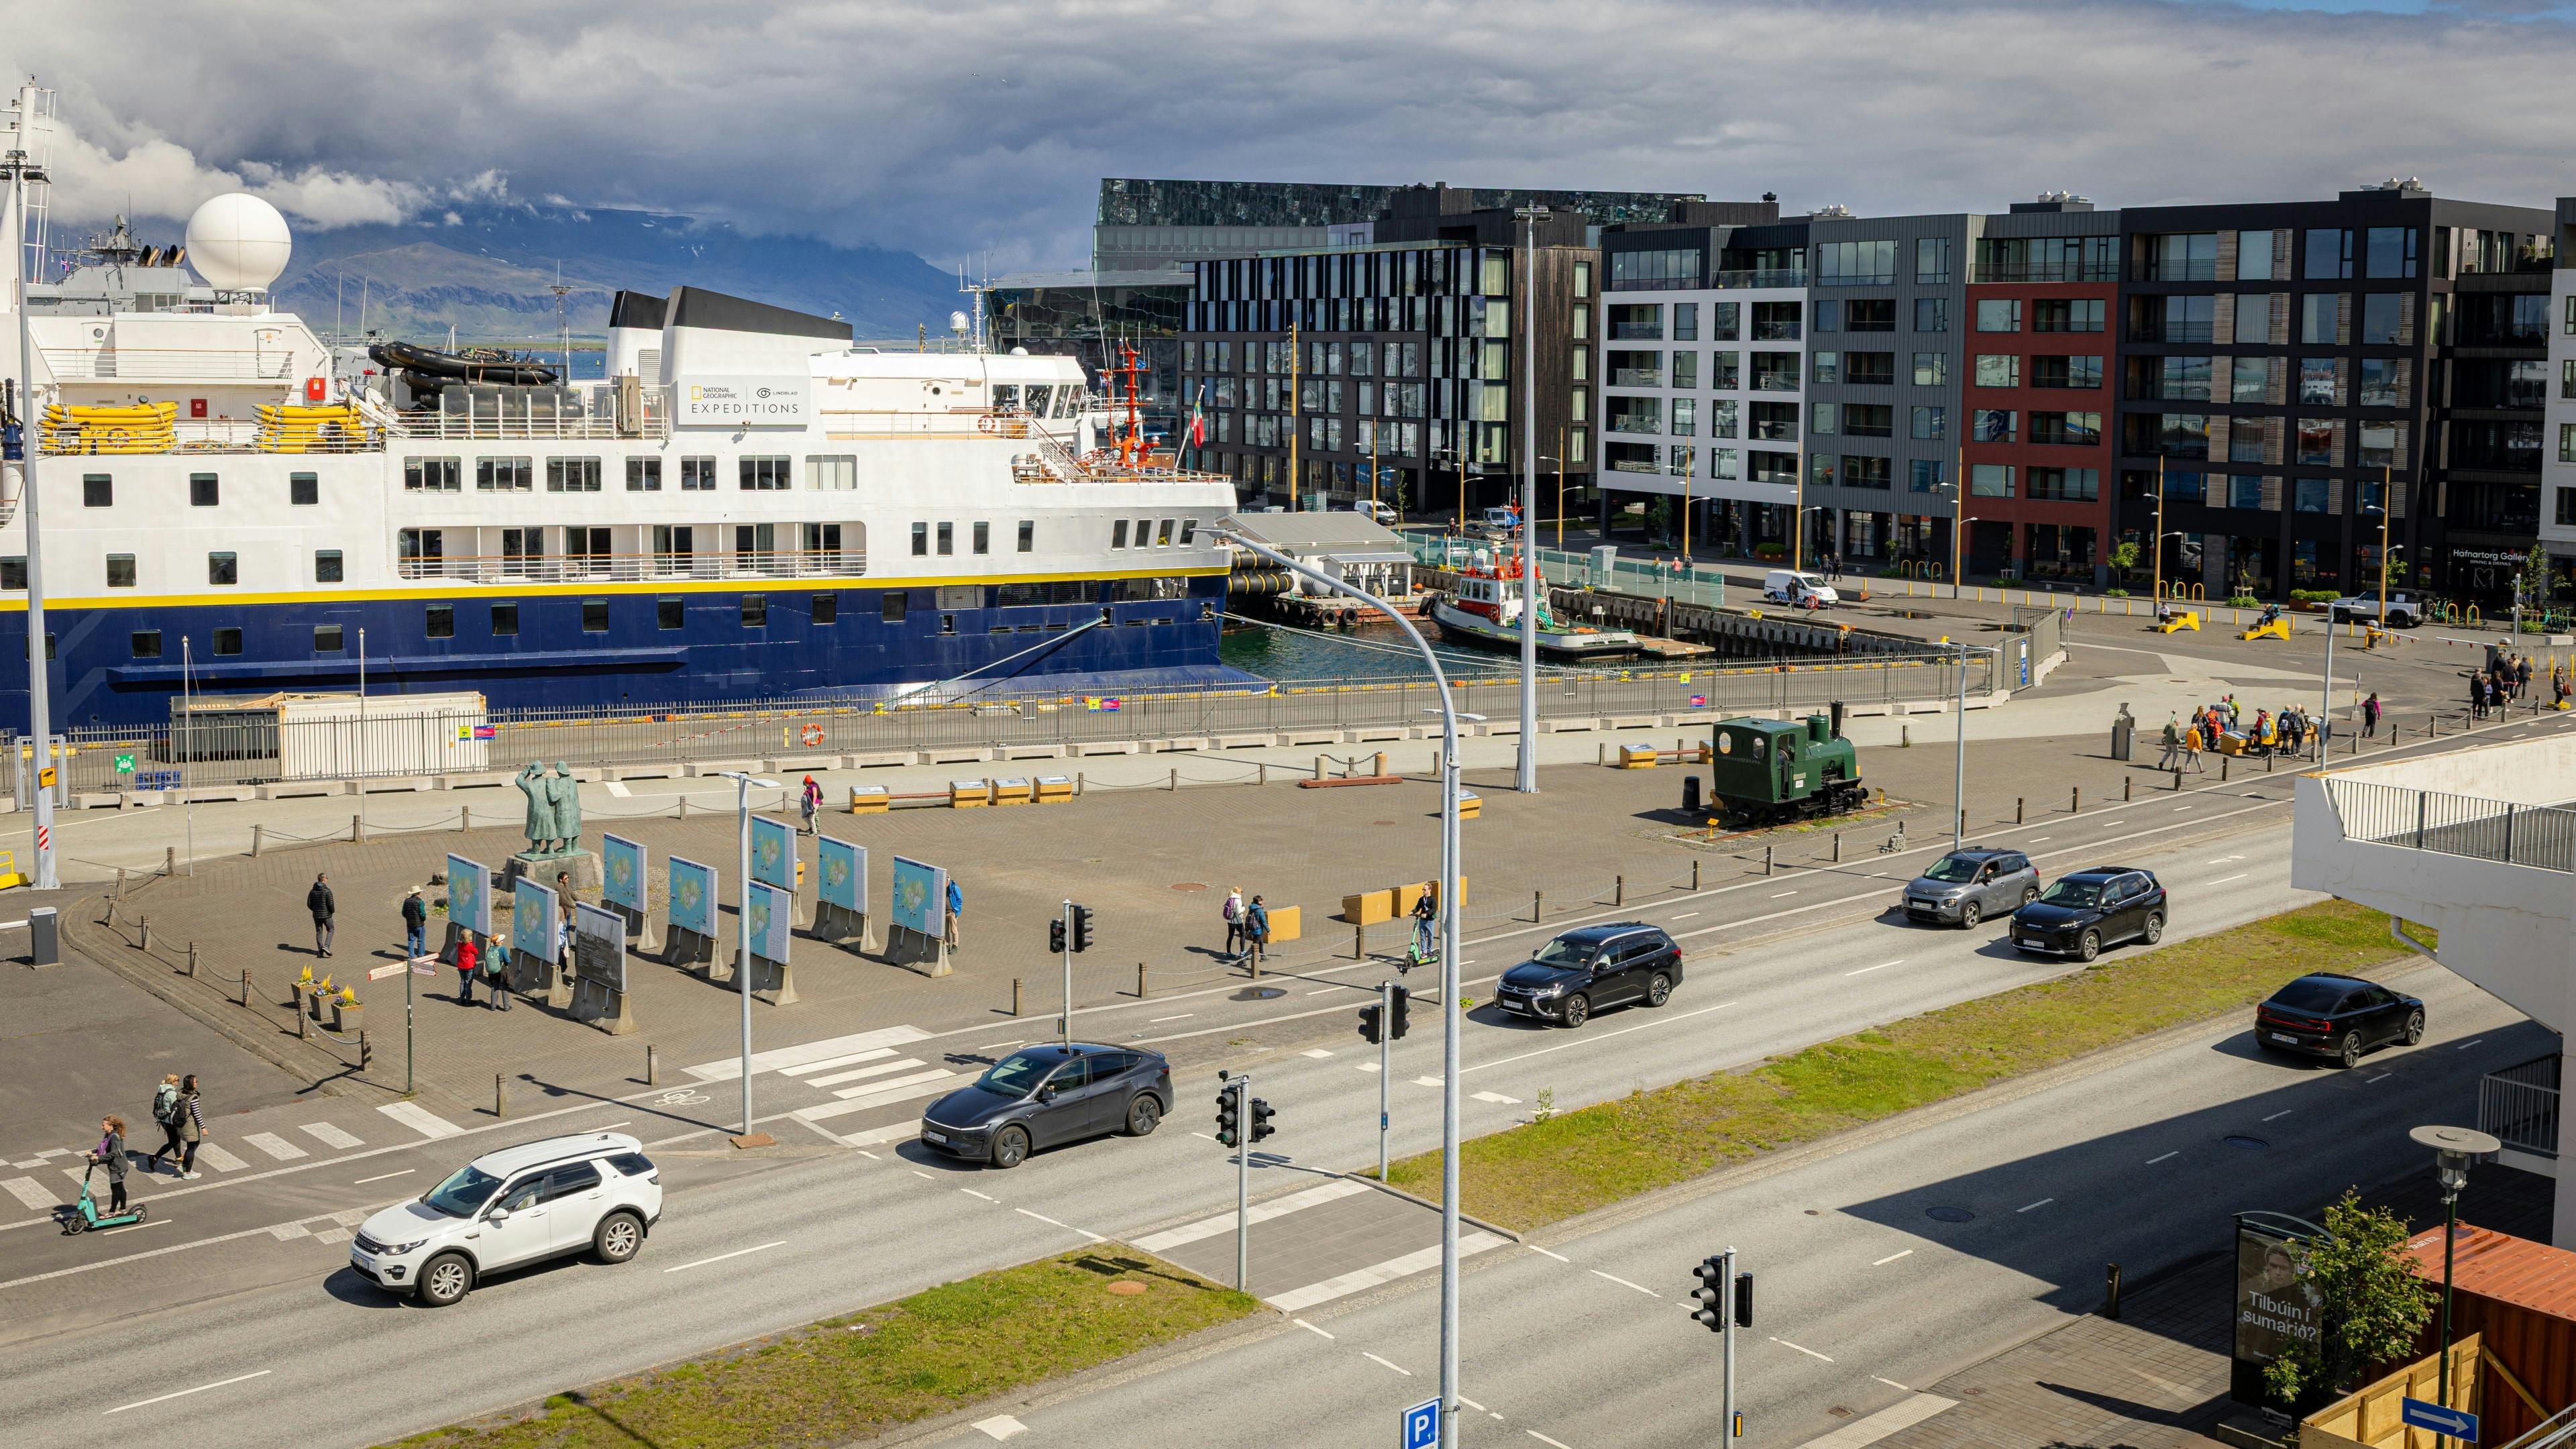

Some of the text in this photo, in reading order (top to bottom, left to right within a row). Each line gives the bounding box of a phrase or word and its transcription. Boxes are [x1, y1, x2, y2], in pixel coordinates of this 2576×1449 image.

[692, 404, 798, 413] EXPEDITIONS
[2453, 549, 2530, 563] Hafnartorg Gallery
[2249, 1290, 2312, 1322] Tilbúin í
[2243, 1310, 2316, 1342] sumarið?
[1415, 1414, 1430, 1442] P
[1427, 1432, 1431, 1440] 1
